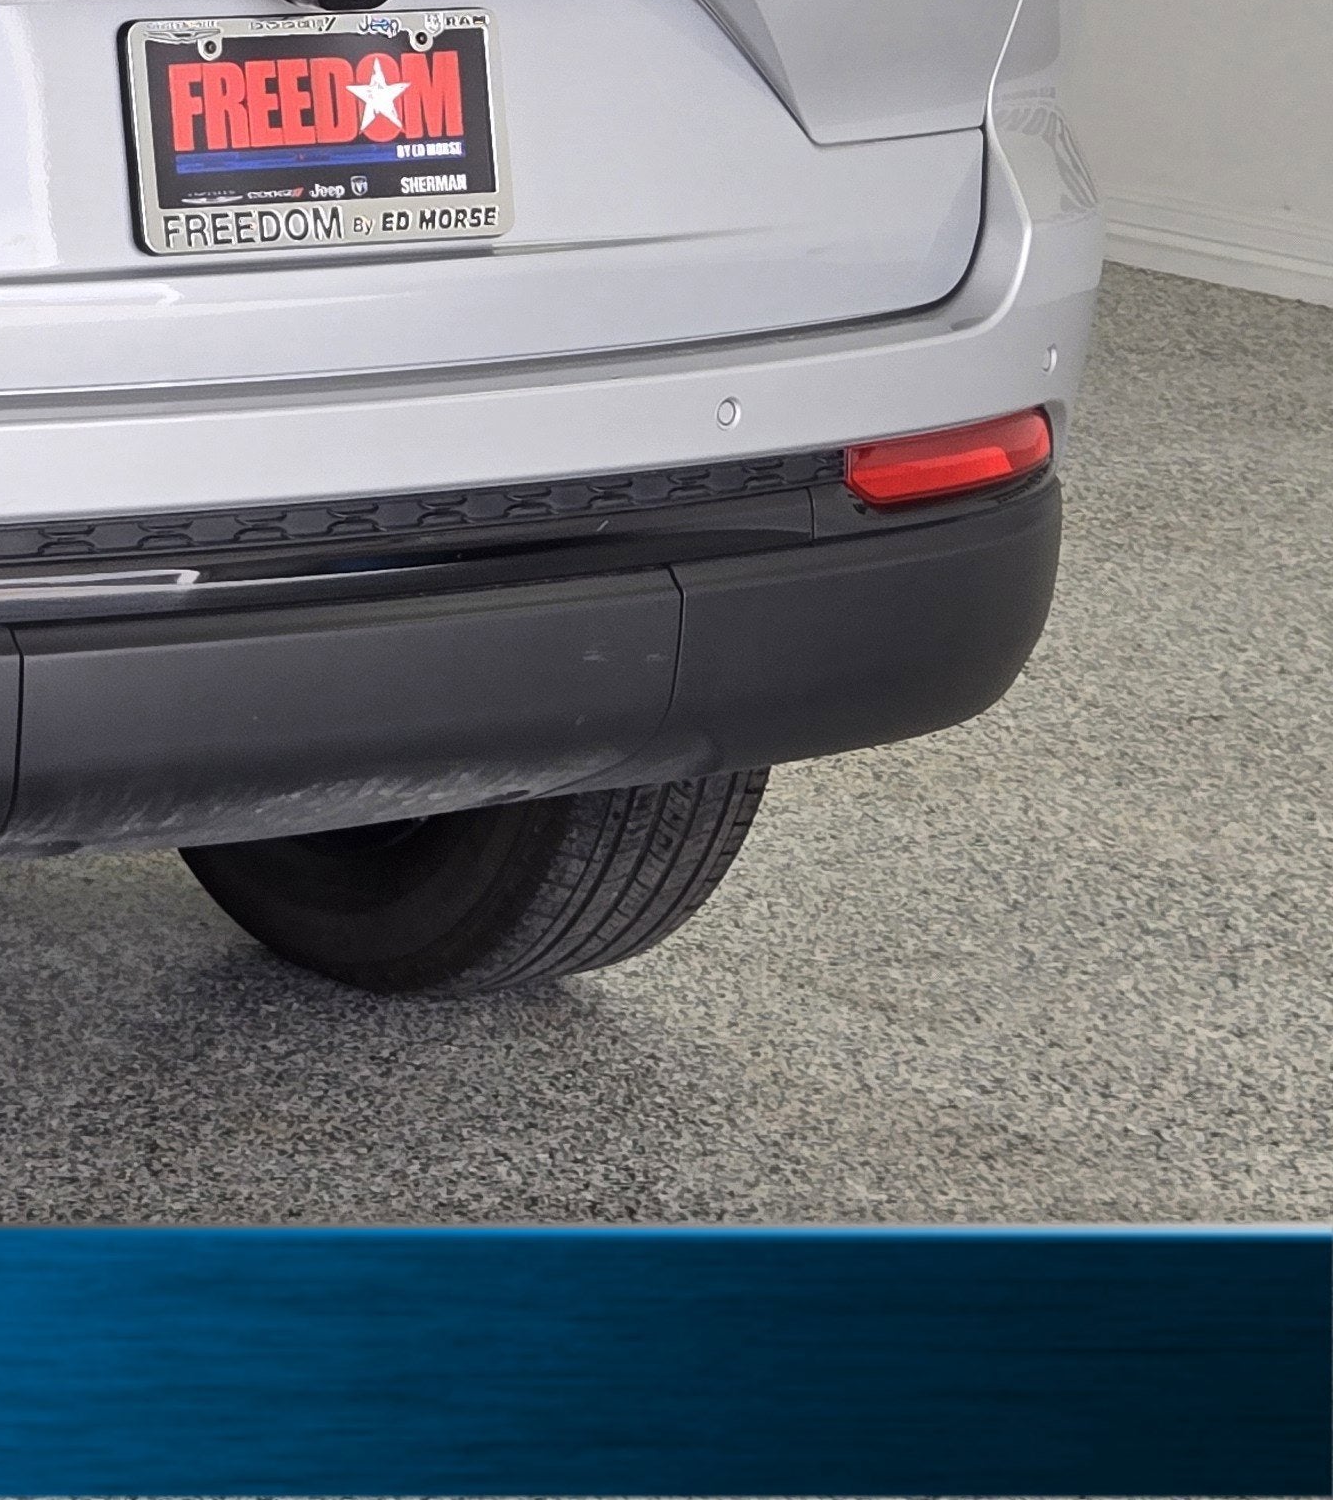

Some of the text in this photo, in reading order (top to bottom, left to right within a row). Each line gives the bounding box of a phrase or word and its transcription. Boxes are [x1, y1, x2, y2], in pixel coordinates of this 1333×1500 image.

[168, 50, 464, 152] FREEDOM
[309, 183, 346, 199] Jeep
[400, 173, 468, 194] SHERMAN
[162, 205, 343, 248] FREEDOM
[381, 211, 412, 232] ED
[418, 206, 497, 231] MORSE
